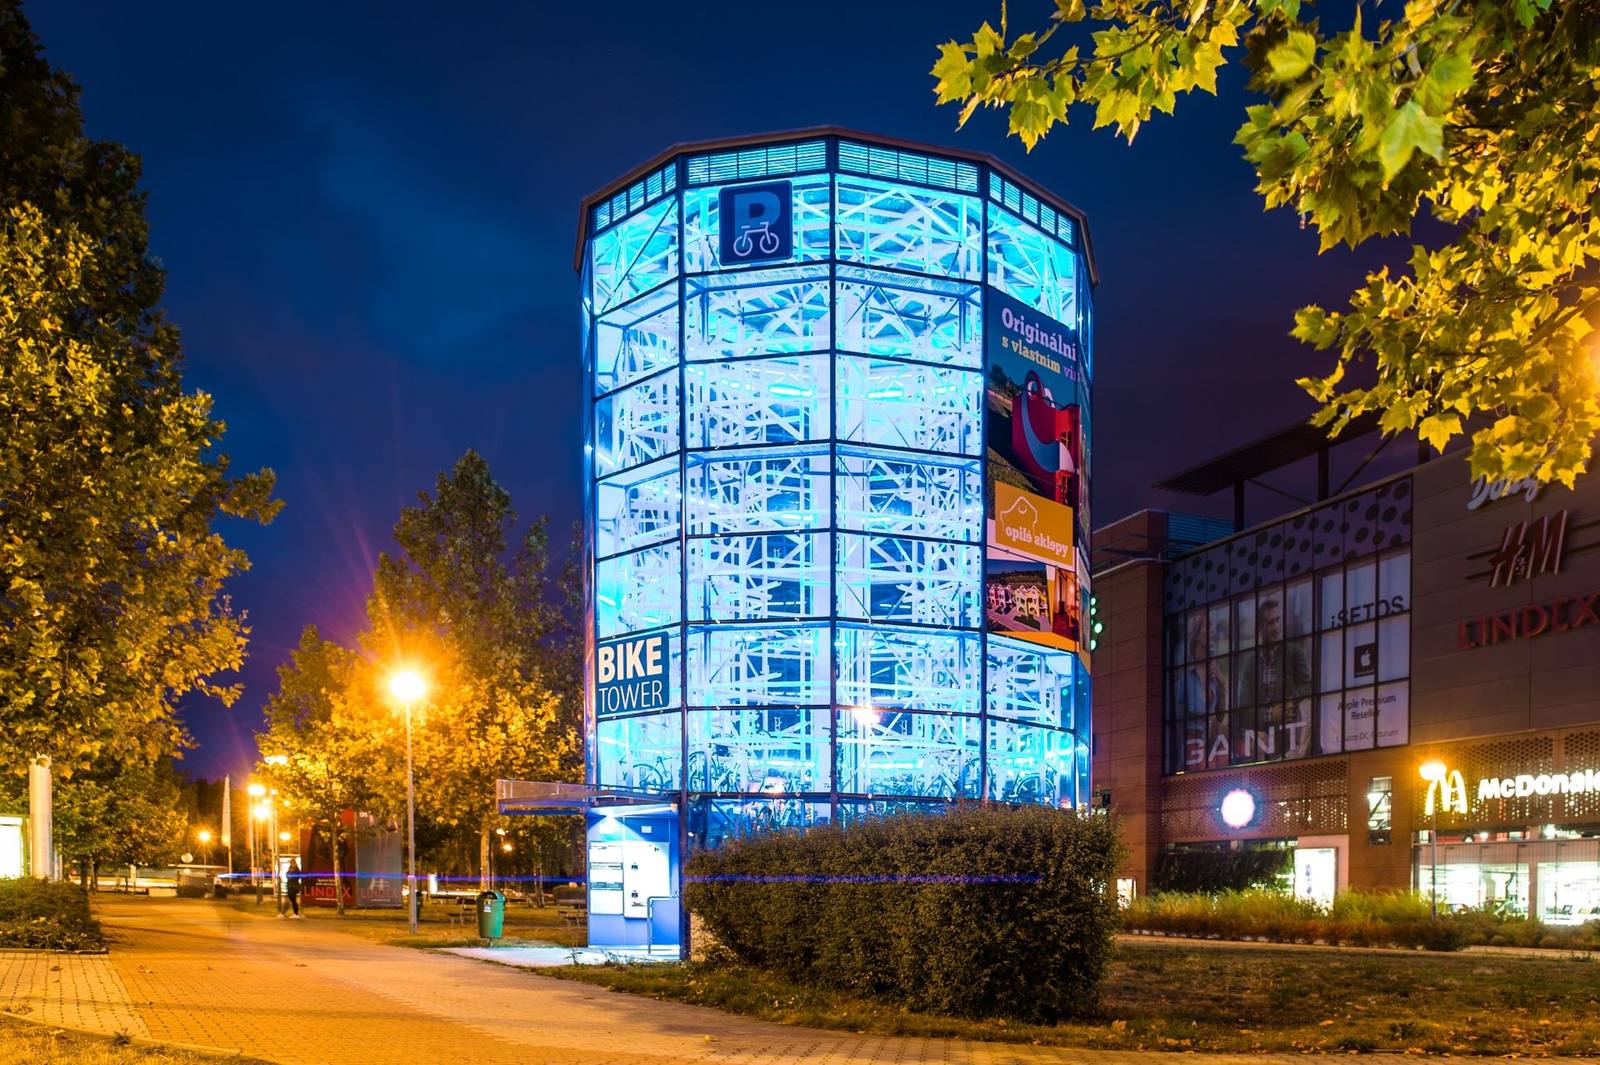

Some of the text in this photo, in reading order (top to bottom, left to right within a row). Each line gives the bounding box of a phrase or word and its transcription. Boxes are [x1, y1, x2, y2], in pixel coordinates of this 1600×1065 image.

[733, 190, 781, 238] P
[1001, 307, 1077, 362] Originální
[1001, 336, 1009, 348] s
[1489, 510, 1567, 587] H&M
[1457, 592, 1600, 649] LINDEX
[598, 636, 663, 684] BIKE
[598, 680, 663, 713] TOWER
[1351, 709, 1380, 720] Resellr
[1186, 721, 1308, 766] GANT
[304, 886, 351, 898] LINDX
